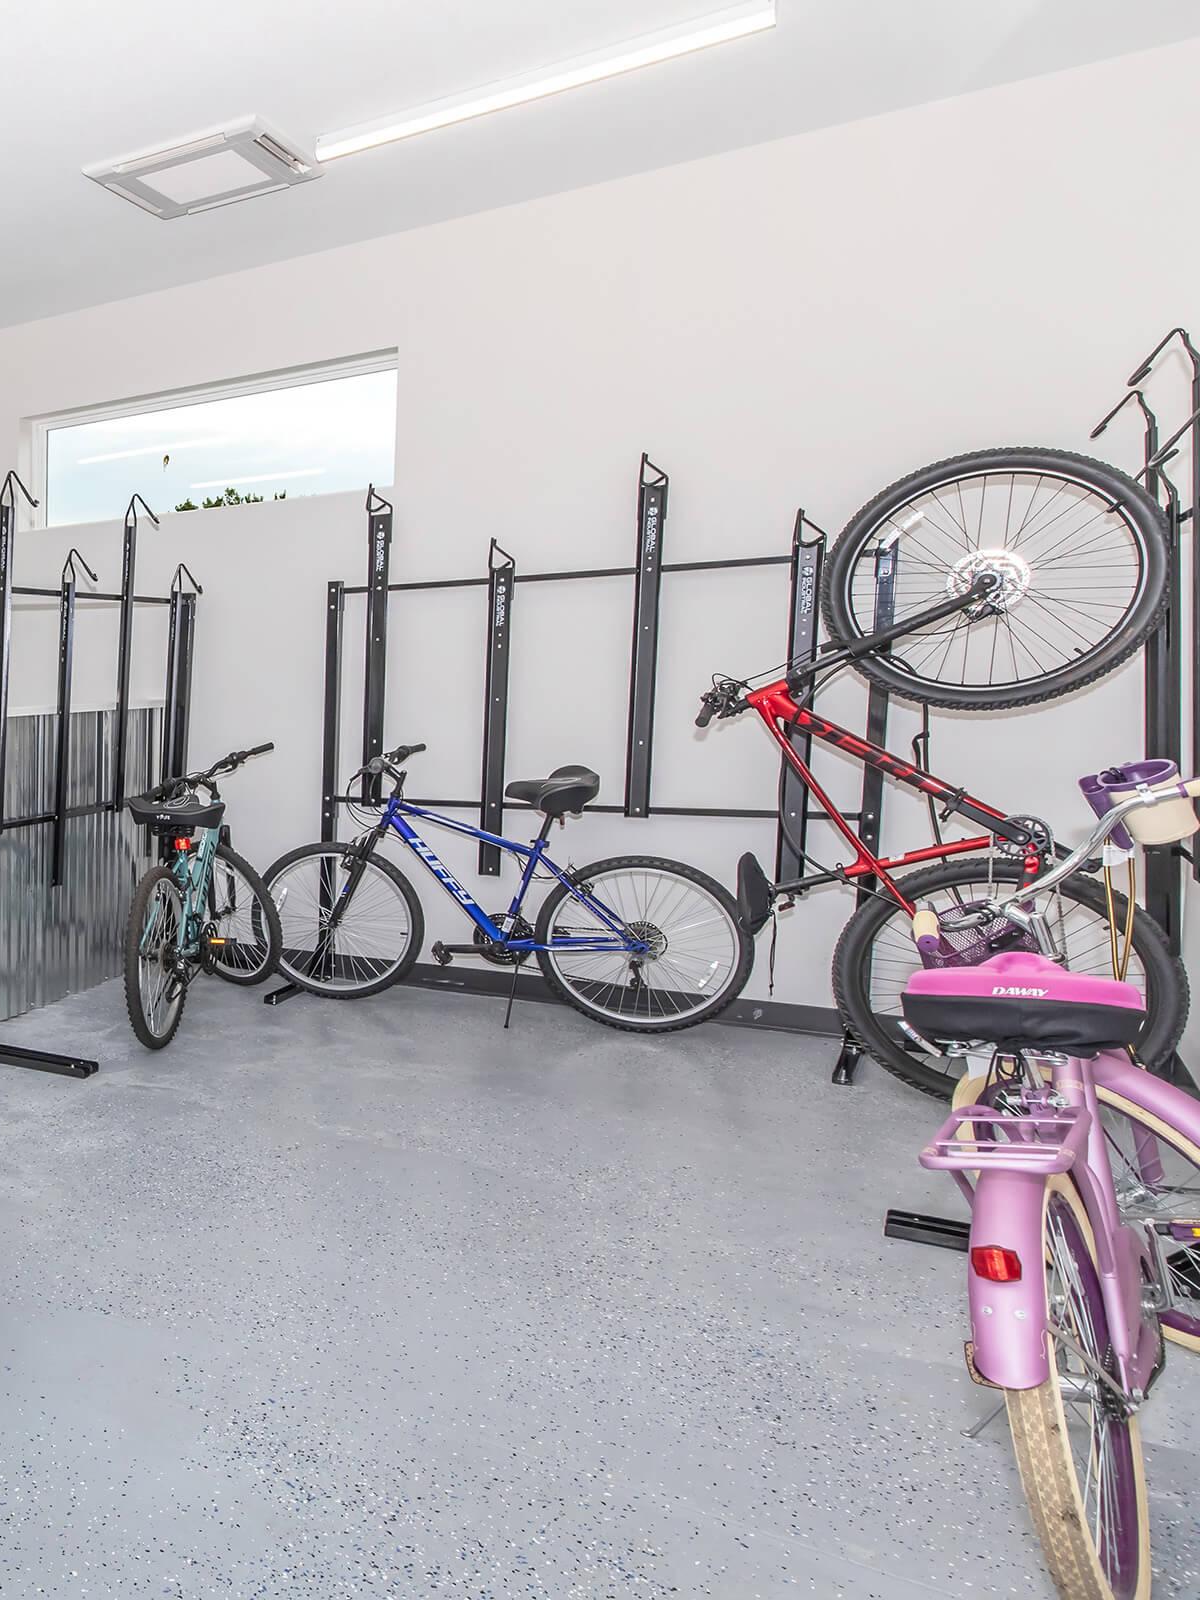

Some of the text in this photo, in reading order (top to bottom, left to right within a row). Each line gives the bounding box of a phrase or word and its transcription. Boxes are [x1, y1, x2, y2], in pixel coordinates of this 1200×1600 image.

[805, 577, 813, 614] GLOBAL
[408, 837, 475, 905] HUFFY
[992, 986, 1049, 997] DAWAY
